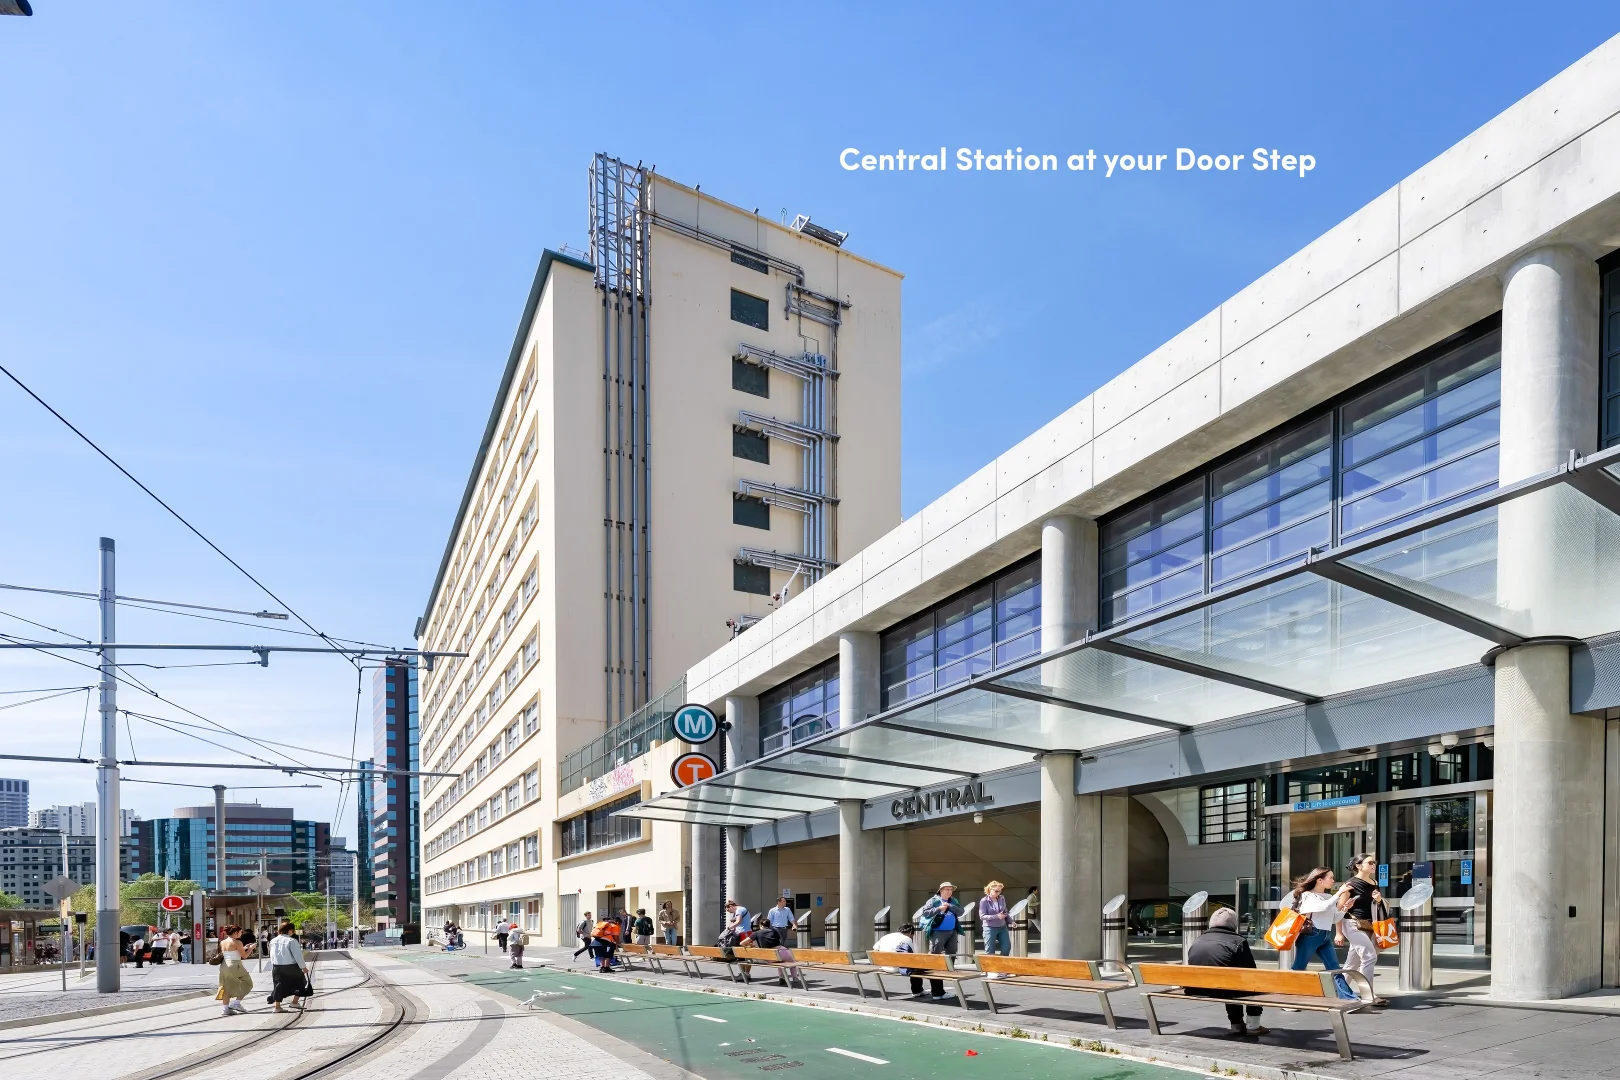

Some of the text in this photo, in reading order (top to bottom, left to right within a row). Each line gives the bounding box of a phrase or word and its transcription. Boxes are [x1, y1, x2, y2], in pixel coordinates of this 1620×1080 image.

[684, 713, 707, 735] M
[686, 763, 705, 784] T
[890, 782, 994, 818] CENTRAL
[168, 898, 178, 908] L
